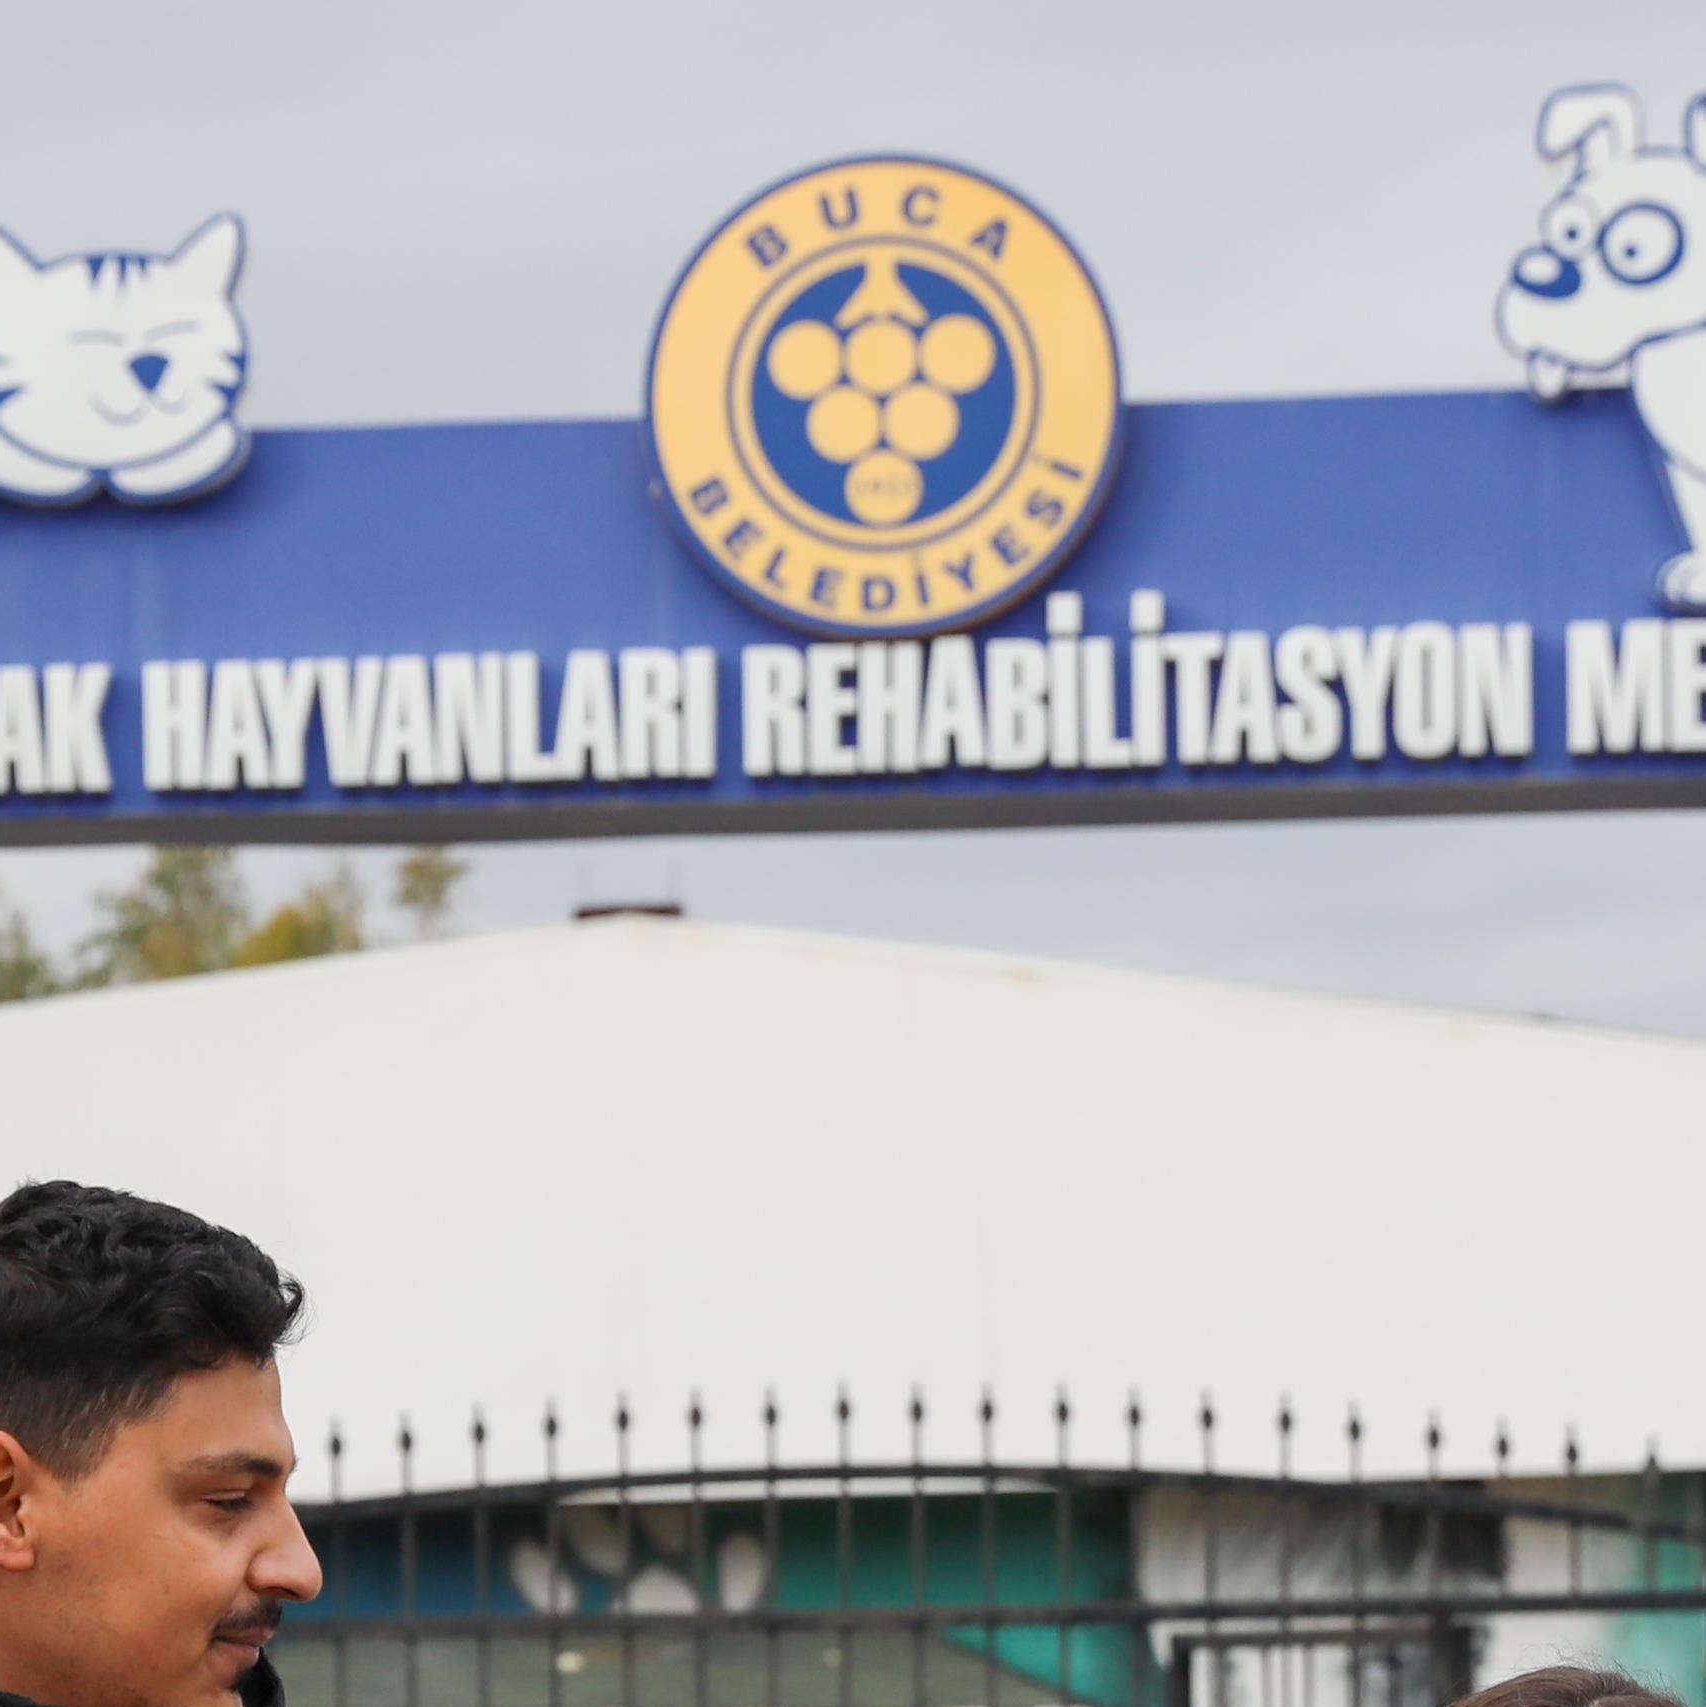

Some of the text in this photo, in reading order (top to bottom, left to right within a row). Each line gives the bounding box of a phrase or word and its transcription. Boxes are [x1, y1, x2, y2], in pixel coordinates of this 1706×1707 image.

[743, 185, 1011, 270] BUCA
[690, 455, 1084, 613] BELEDİYESİ
[140, 645, 719, 791] HAYVANLARI
[740, 588, 1534, 778] REHABİLİTASYON
